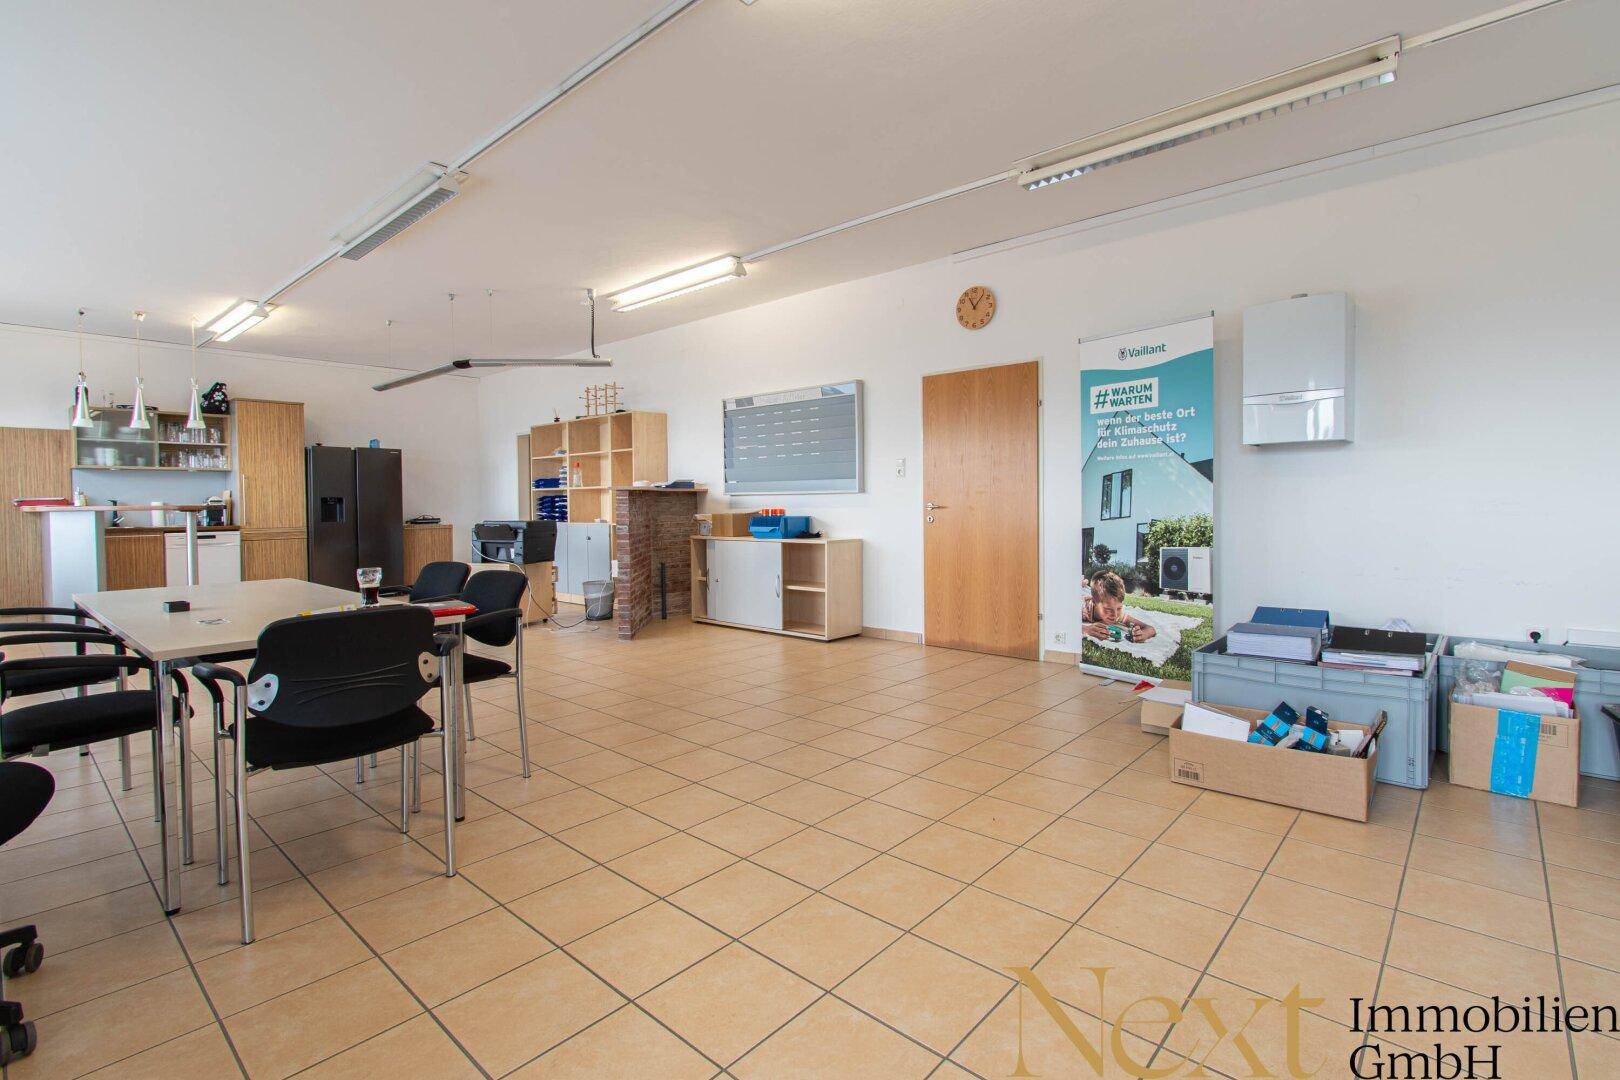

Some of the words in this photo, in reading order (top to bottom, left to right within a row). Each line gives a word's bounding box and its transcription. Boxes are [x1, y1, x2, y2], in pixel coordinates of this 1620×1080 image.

[1128, 343, 1167, 358] Vaillant
[1109, 393, 1153, 408] WARTEN
[1097, 415, 1122, 426] wenn
[1125, 412, 1141, 423] der
[1144, 408, 1173, 421] beste
[1176, 406, 1196, 418] Ort
[1097, 427, 1111, 437] für
[1114, 421, 1178, 436] Klimaschutz
[1097, 437, 1118, 449] dein
[1120, 435, 1163, 447] Zuhause
[1166, 432, 1187, 443] ist?
